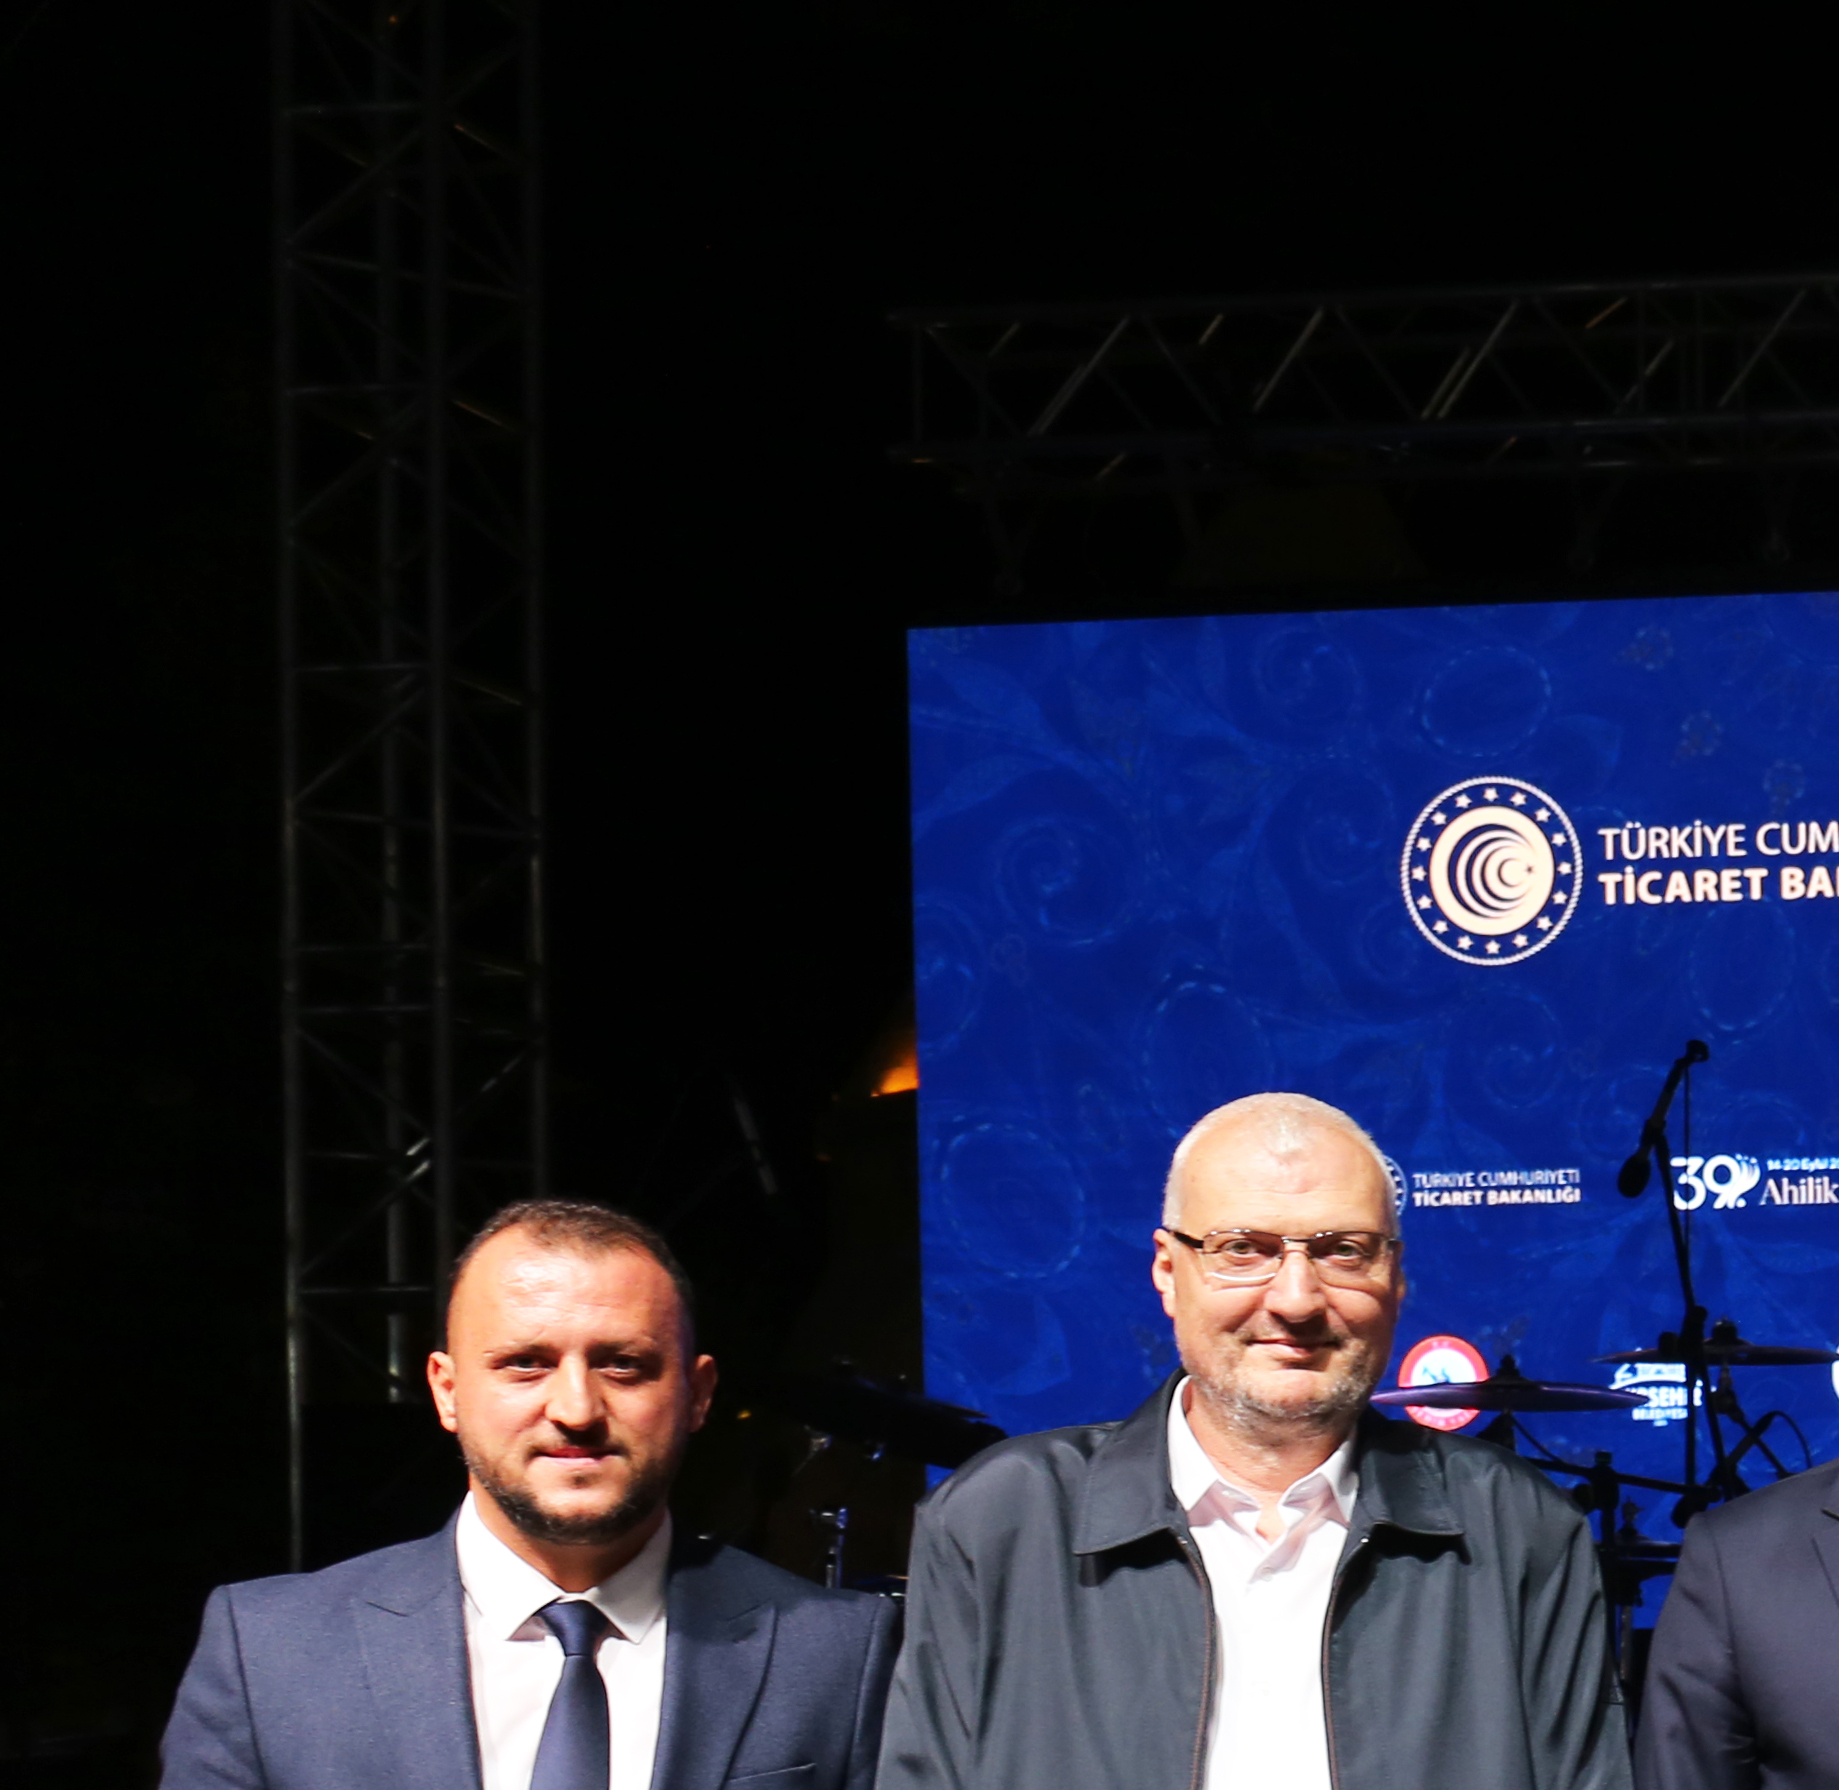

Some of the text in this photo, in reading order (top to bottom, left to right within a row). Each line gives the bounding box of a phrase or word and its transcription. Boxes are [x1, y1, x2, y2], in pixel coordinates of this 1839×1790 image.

[1597, 819, 1748, 862] TÜRKİYE
[1597, 866, 1769, 906] TİCARET
[1487, 1186, 1581, 1205] BAKANLIĞI
[1759, 1176, 1839, 1206] Ahilik
